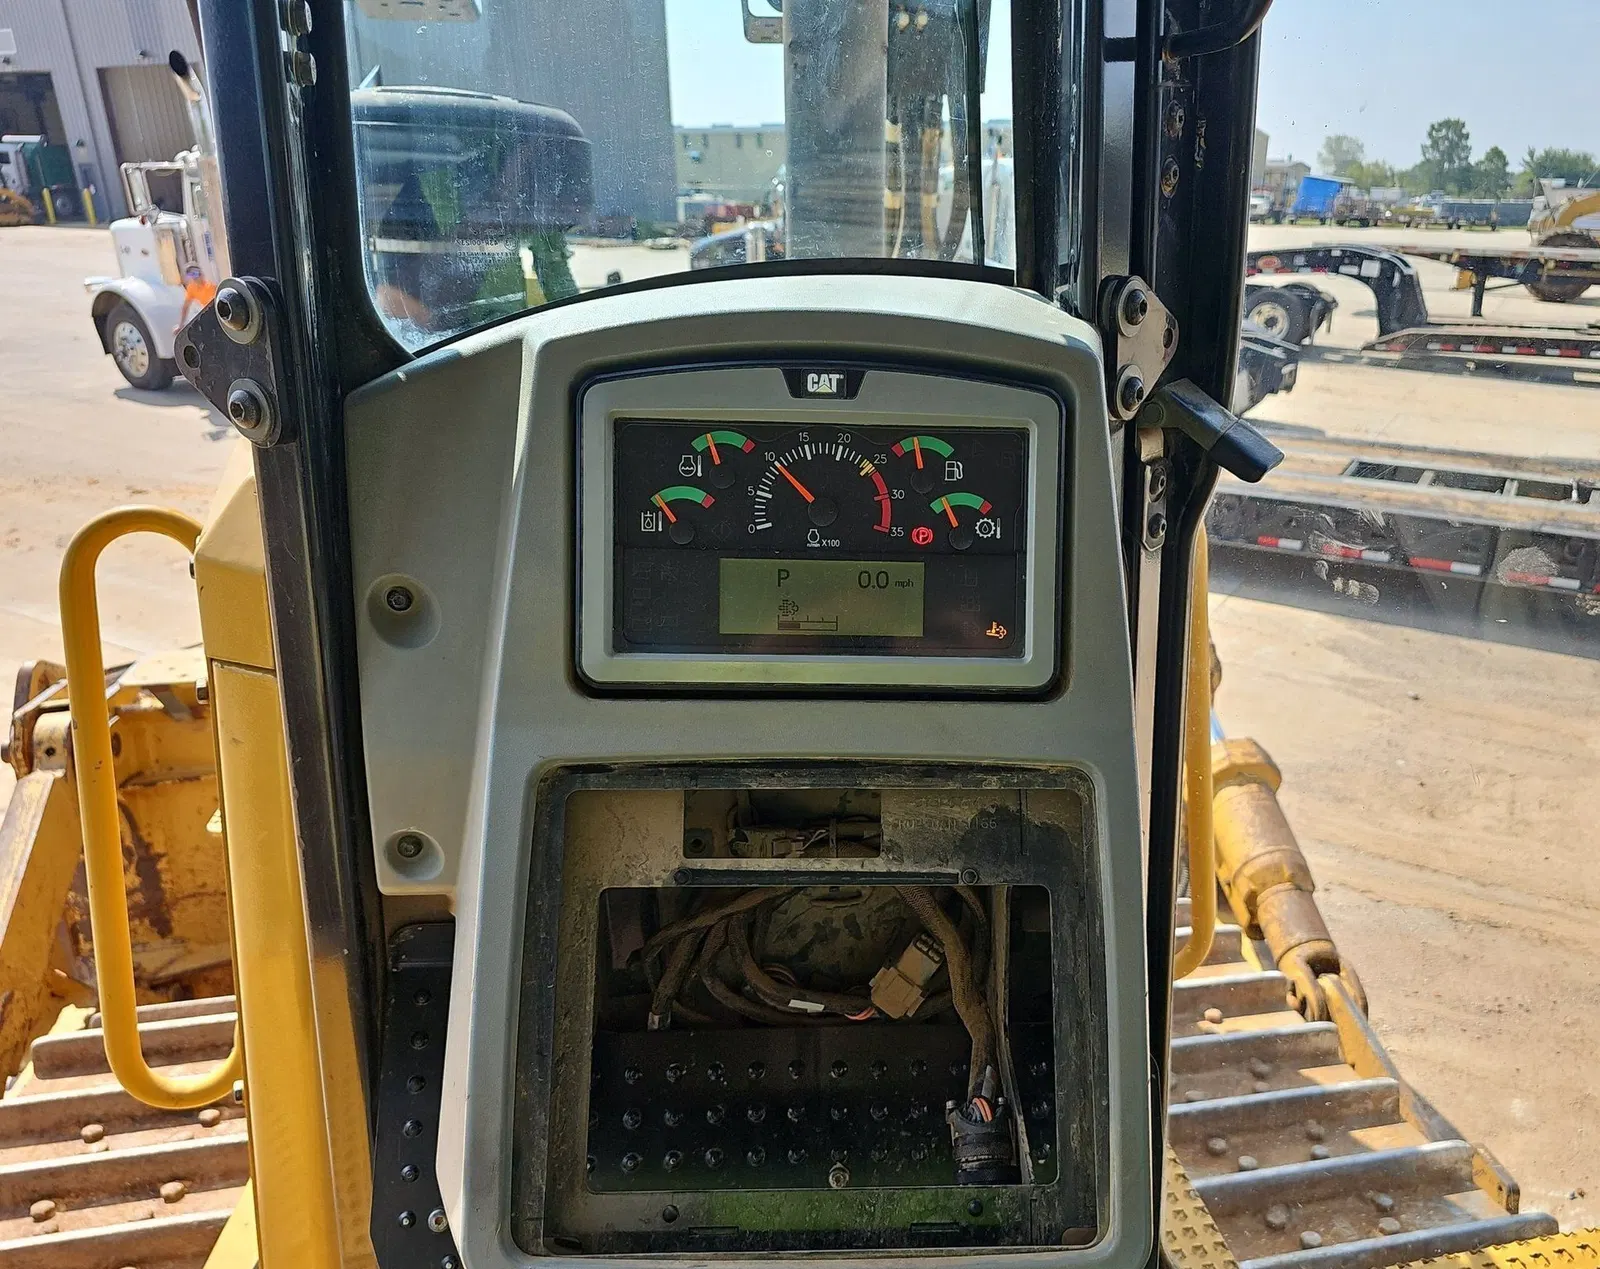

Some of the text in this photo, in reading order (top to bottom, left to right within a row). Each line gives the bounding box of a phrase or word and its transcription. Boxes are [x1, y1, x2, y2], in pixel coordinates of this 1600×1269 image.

[807, 373, 840, 393] CAT
[798, 432, 810, 442] 15
[837, 433, 851, 443] 20
[764, 452, 776, 461] 10
[873, 454, 888, 464] 25
[747, 486, 755, 496] 5
[891, 489, 905, 499] 30
[747, 524, 756, 534] 0
[890, 527, 904, 537] 35
[821, 539, 840, 547] X100
[777, 568, 790, 588] P
[857, 570, 914, 589] 0.0 mph
